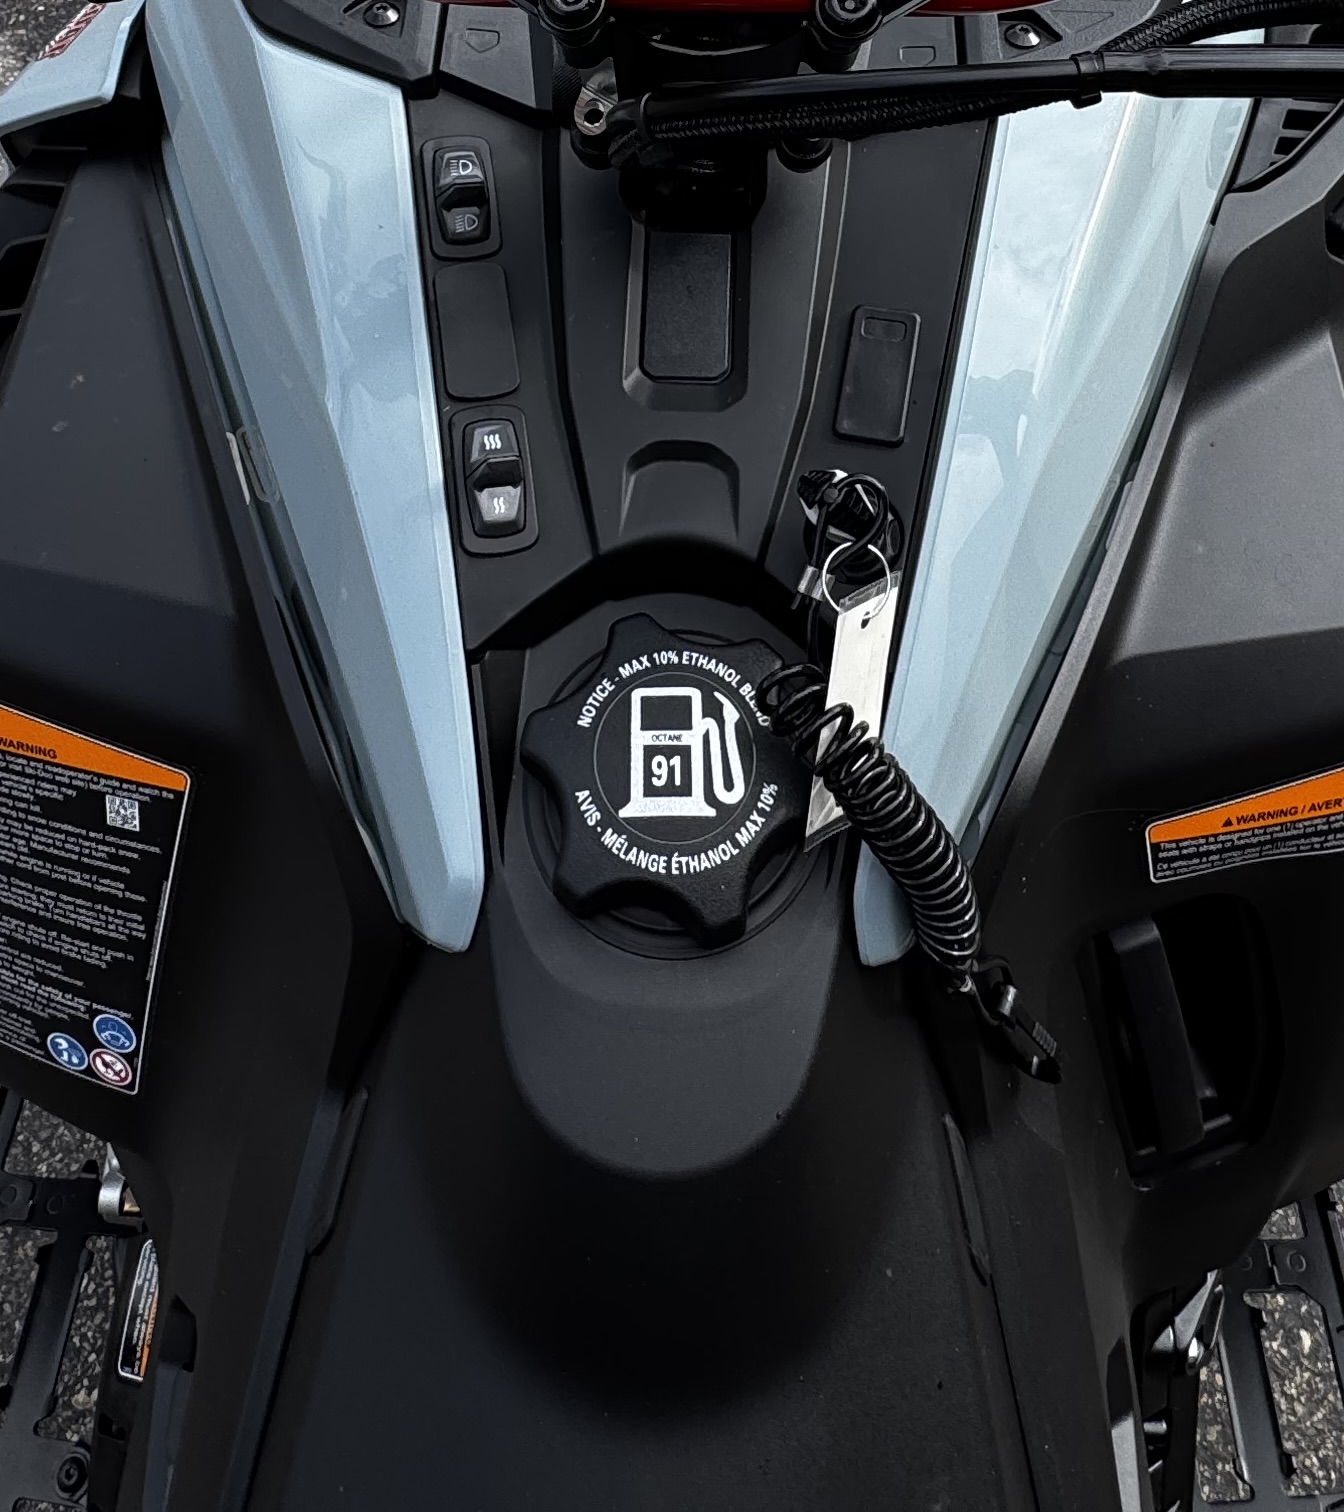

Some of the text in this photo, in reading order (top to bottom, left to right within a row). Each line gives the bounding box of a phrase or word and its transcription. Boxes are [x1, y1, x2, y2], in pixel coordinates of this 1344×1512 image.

[577, 676, 616, 728] NOTICE
[618, 654, 652, 680] MAX
[652, 650, 679, 666] 10%
[682, 651, 740, 689] ETHANOL
[651, 734, 684, 743] OCTANE
[651, 754, 682, 787] 91
[575, 789, 602, 828] AVIS
[600, 827, 668, 874] MÉLANGE
[670, 839, 741, 876] ÉTHANOL
[734, 810, 767, 848] MAX
[757, 781, 780, 813] 10%
[1236, 807, 1298, 827] WARNING
